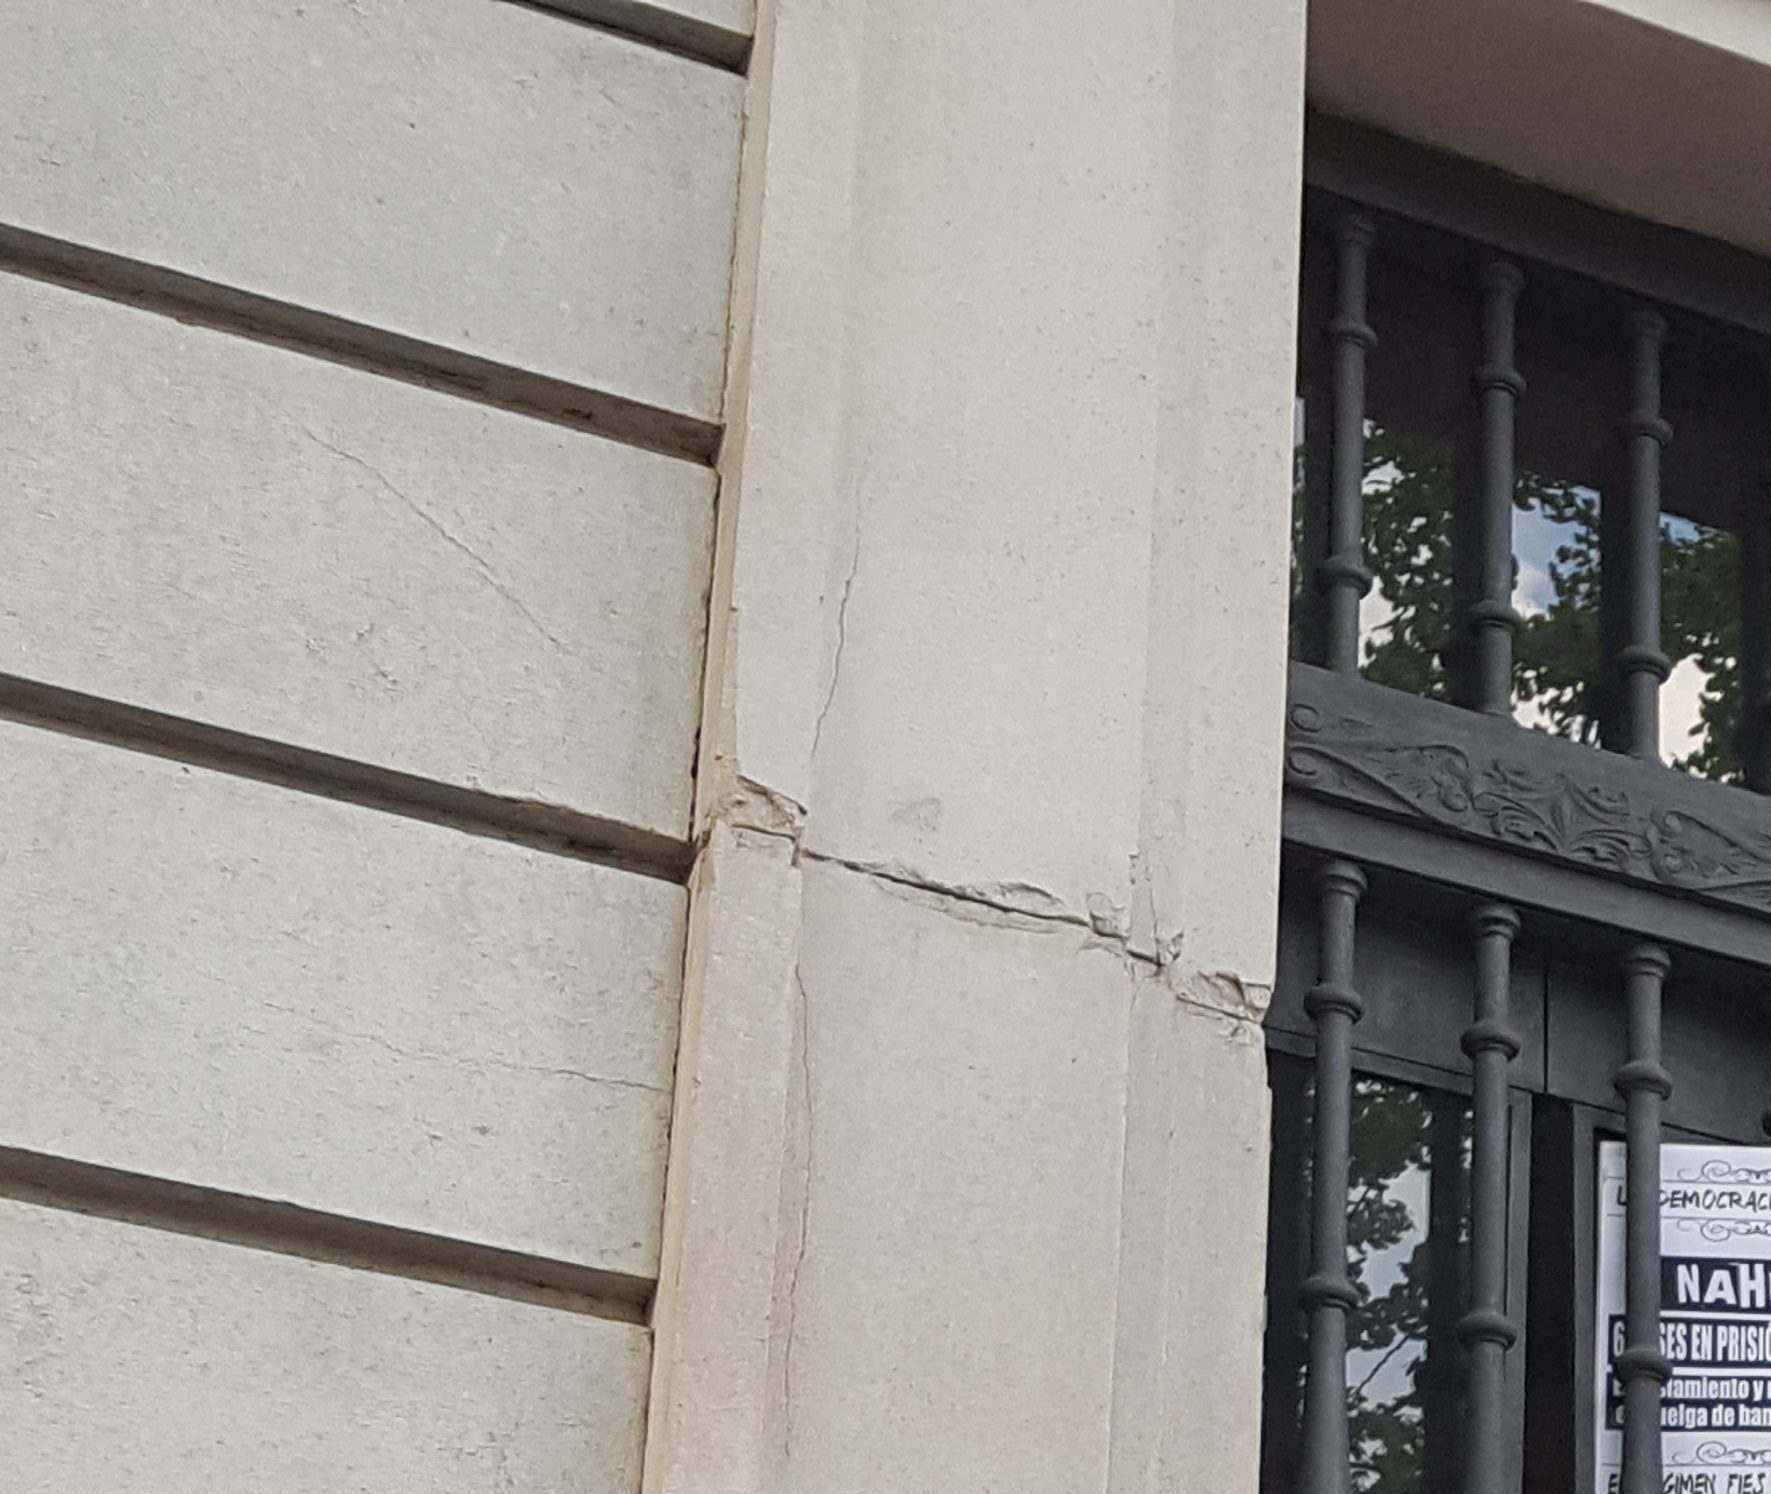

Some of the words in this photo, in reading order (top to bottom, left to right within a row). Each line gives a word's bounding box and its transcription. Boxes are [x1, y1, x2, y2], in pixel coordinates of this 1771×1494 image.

[1690, 1323, 1713, 1362] EN
[1752, 1380, 1764, 1401] y
[1711, 1404, 1735, 1427] de
